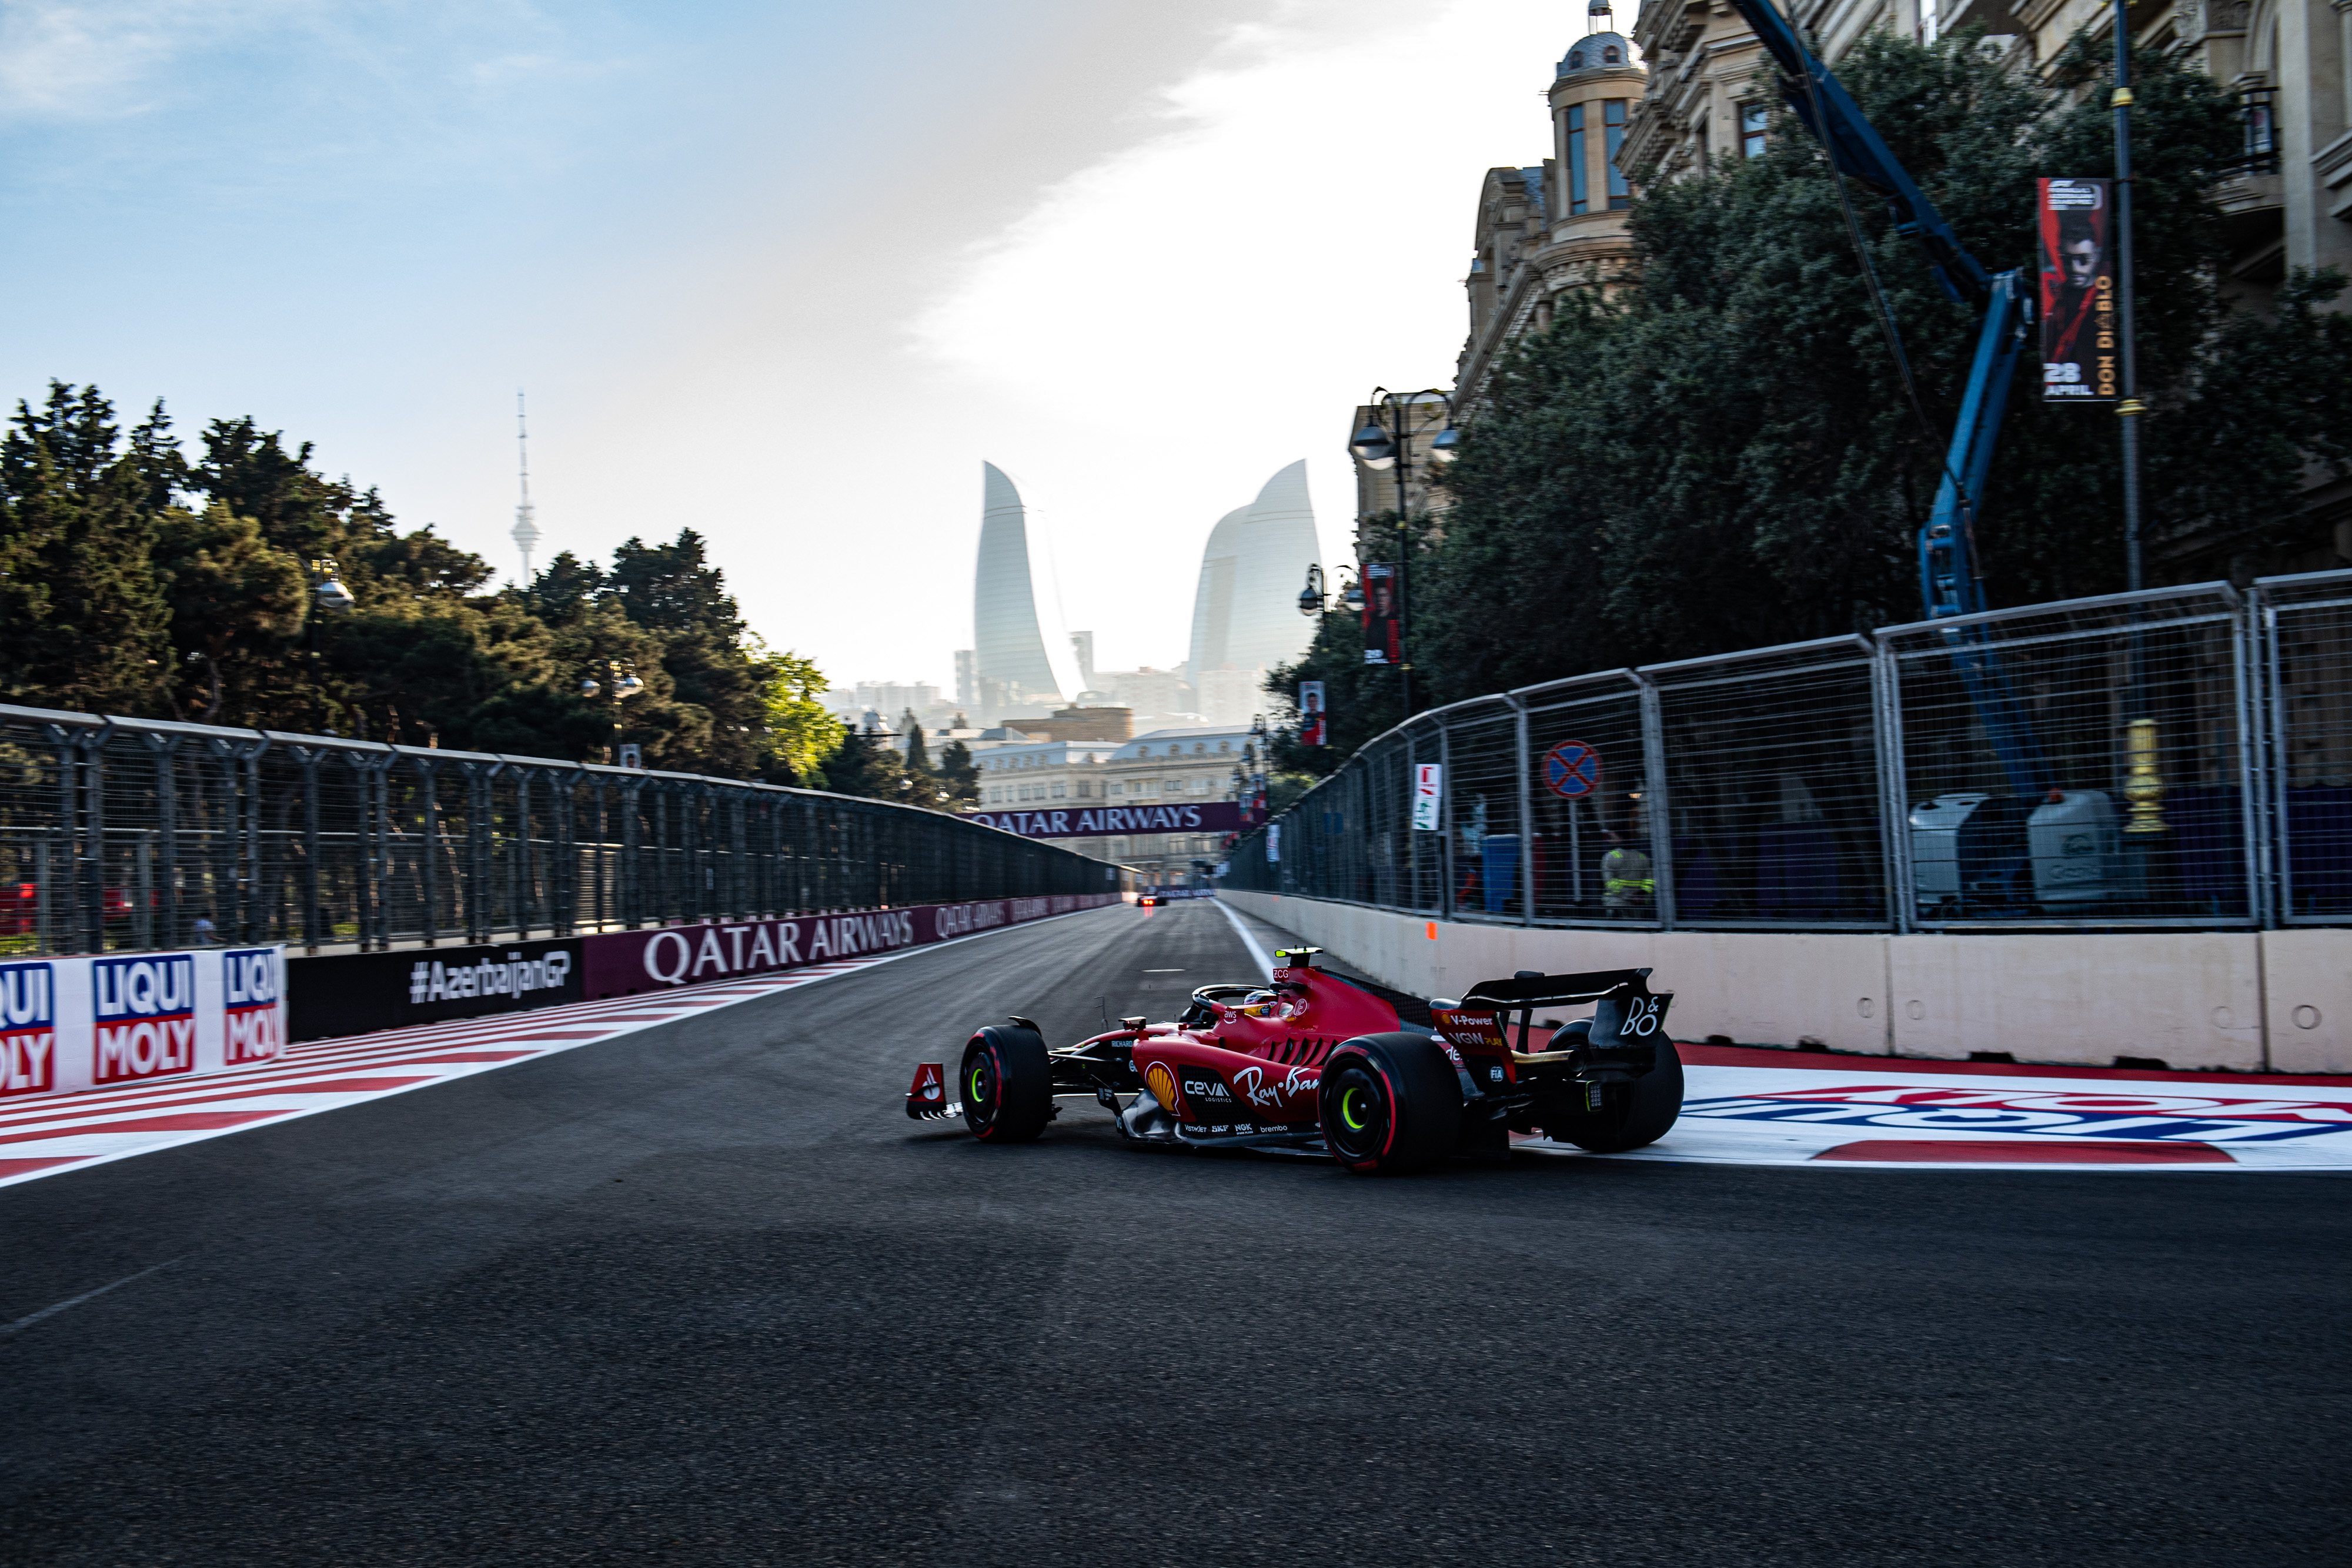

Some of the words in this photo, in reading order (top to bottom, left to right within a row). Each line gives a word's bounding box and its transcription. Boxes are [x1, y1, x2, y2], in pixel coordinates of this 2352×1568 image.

[2094, 275, 2116, 348] DIABLO
[2043, 362, 2082, 383] 28
[2096, 356, 2116, 395] DON
[1075, 805, 1202, 832] AIRWAYS
[643, 922, 803, 985] QATAR
[808, 911, 914, 960] AIRWAYS
[96, 960, 193, 1016] LIQUI
[409, 950, 572, 1004] #AzerbaijanGP
[1224, 1010, 1237, 1018] aws
[1450, 1015, 1493, 1025] V-Power
[96, 1018, 196, 1078] MOLY
[1448, 1032, 1485, 1045] VGW
[1235, 1123, 1252, 1132] NGK
[1260, 1125, 1288, 1133] brembo
